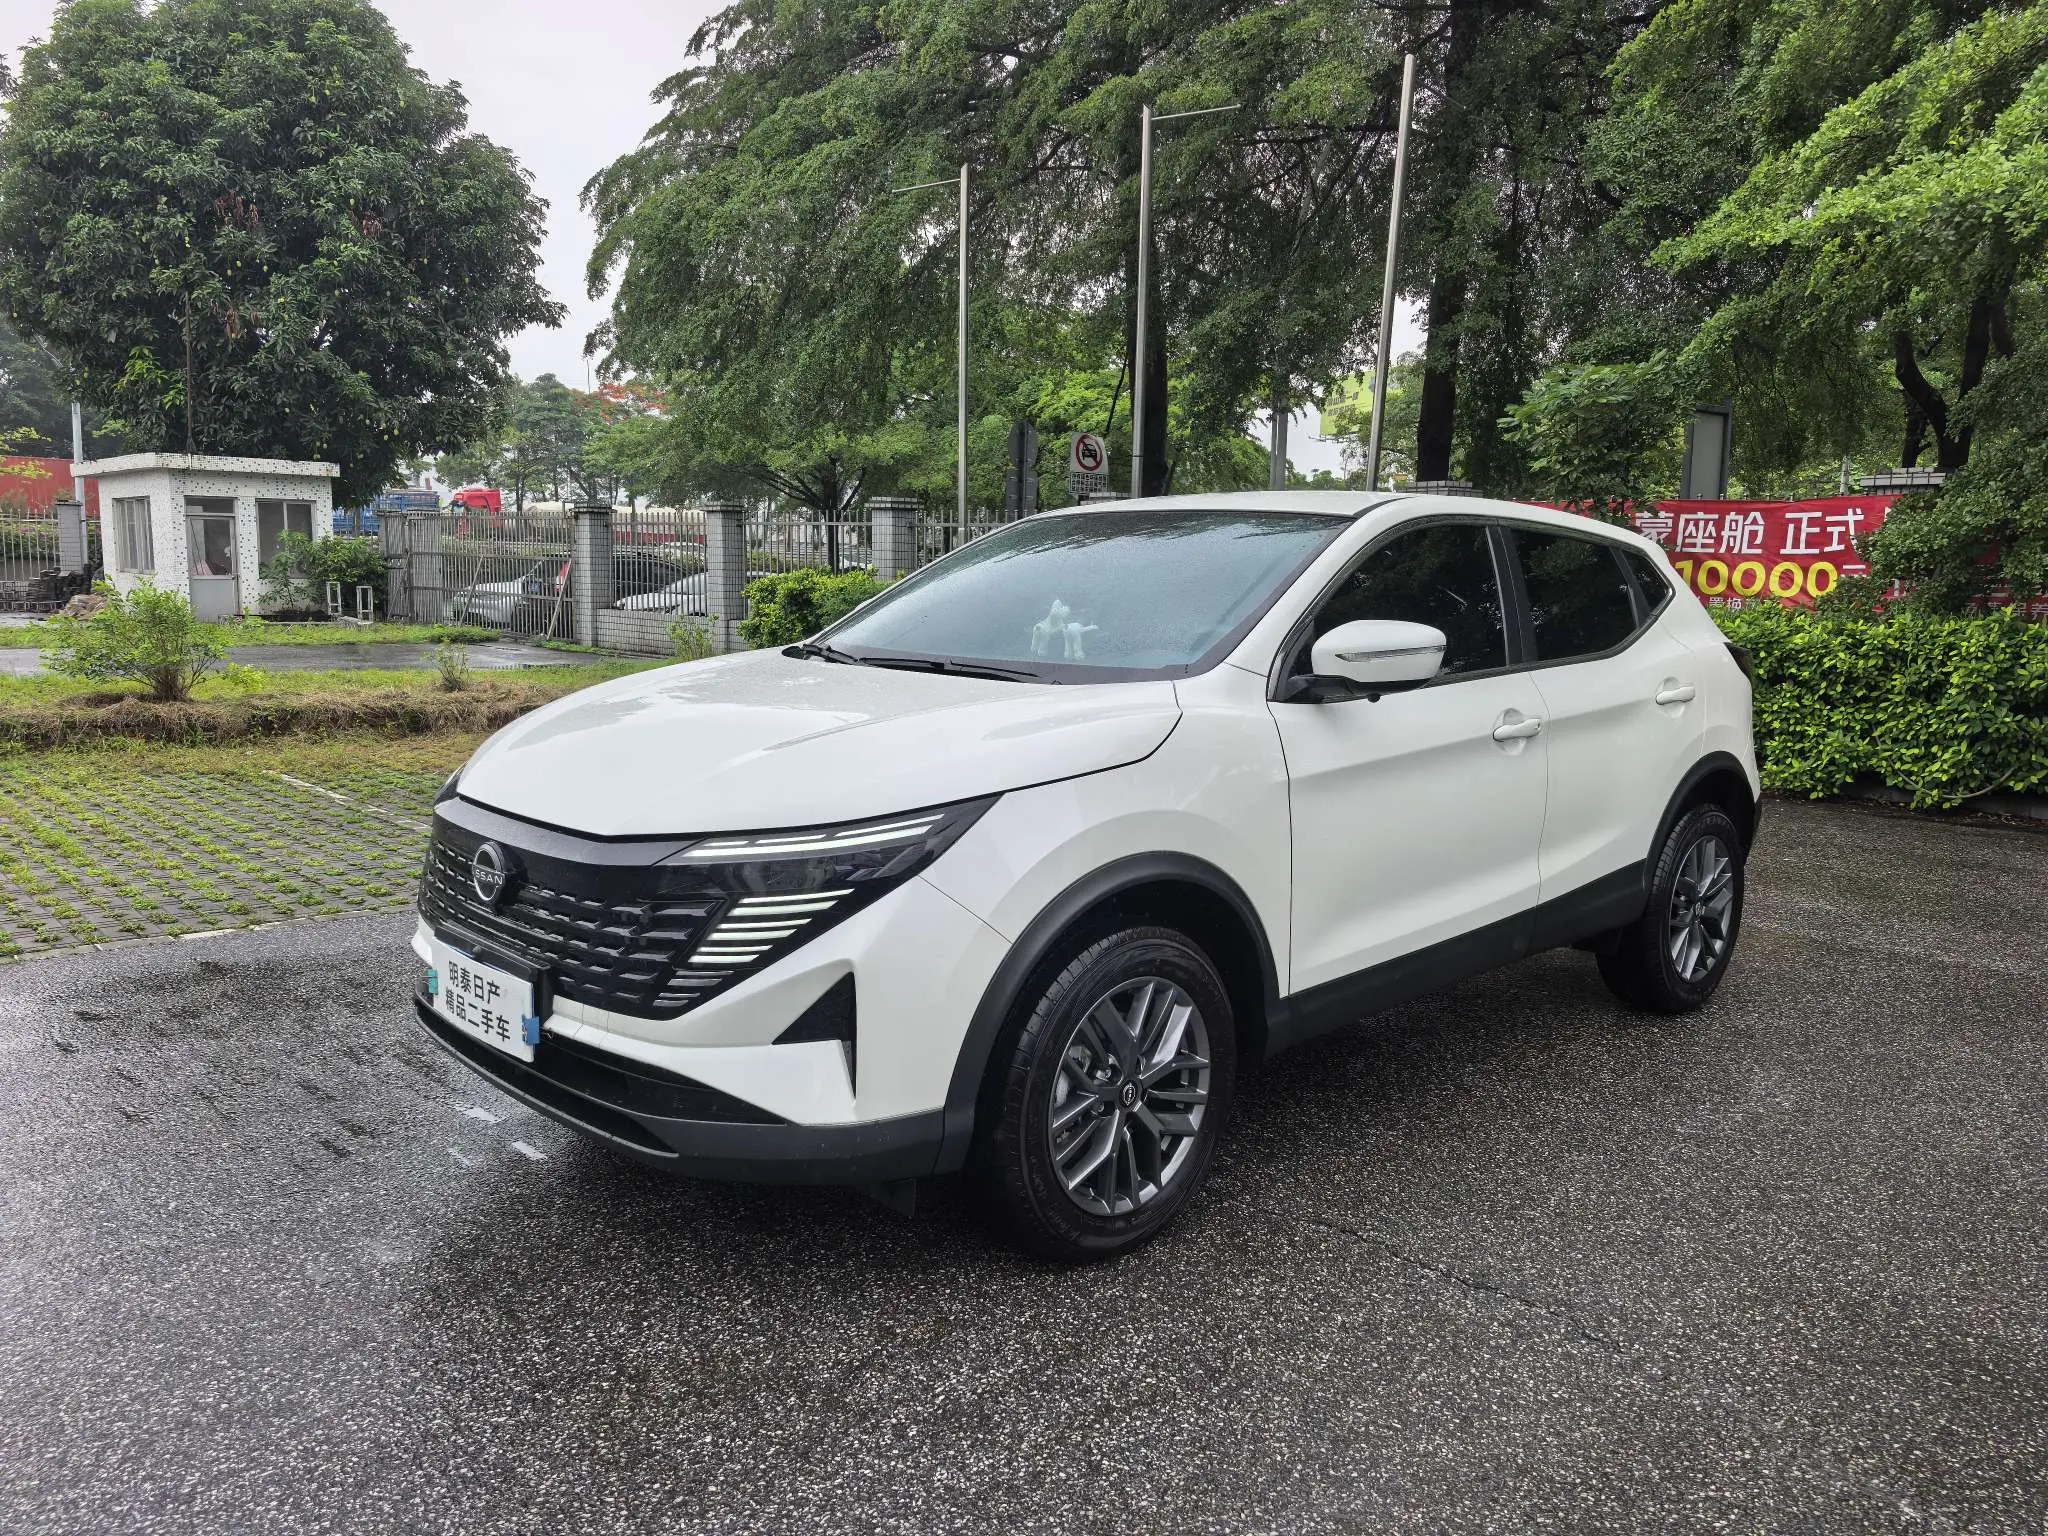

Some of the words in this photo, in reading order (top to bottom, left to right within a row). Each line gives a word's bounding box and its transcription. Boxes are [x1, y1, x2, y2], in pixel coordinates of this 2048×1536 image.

[1635, 511, 1765, 554] 蒙座舱
[1780, 508, 1864, 555] 正式
[449, 960, 500, 1004] 明泰日产
[445, 987, 511, 1042] 精品二手车
